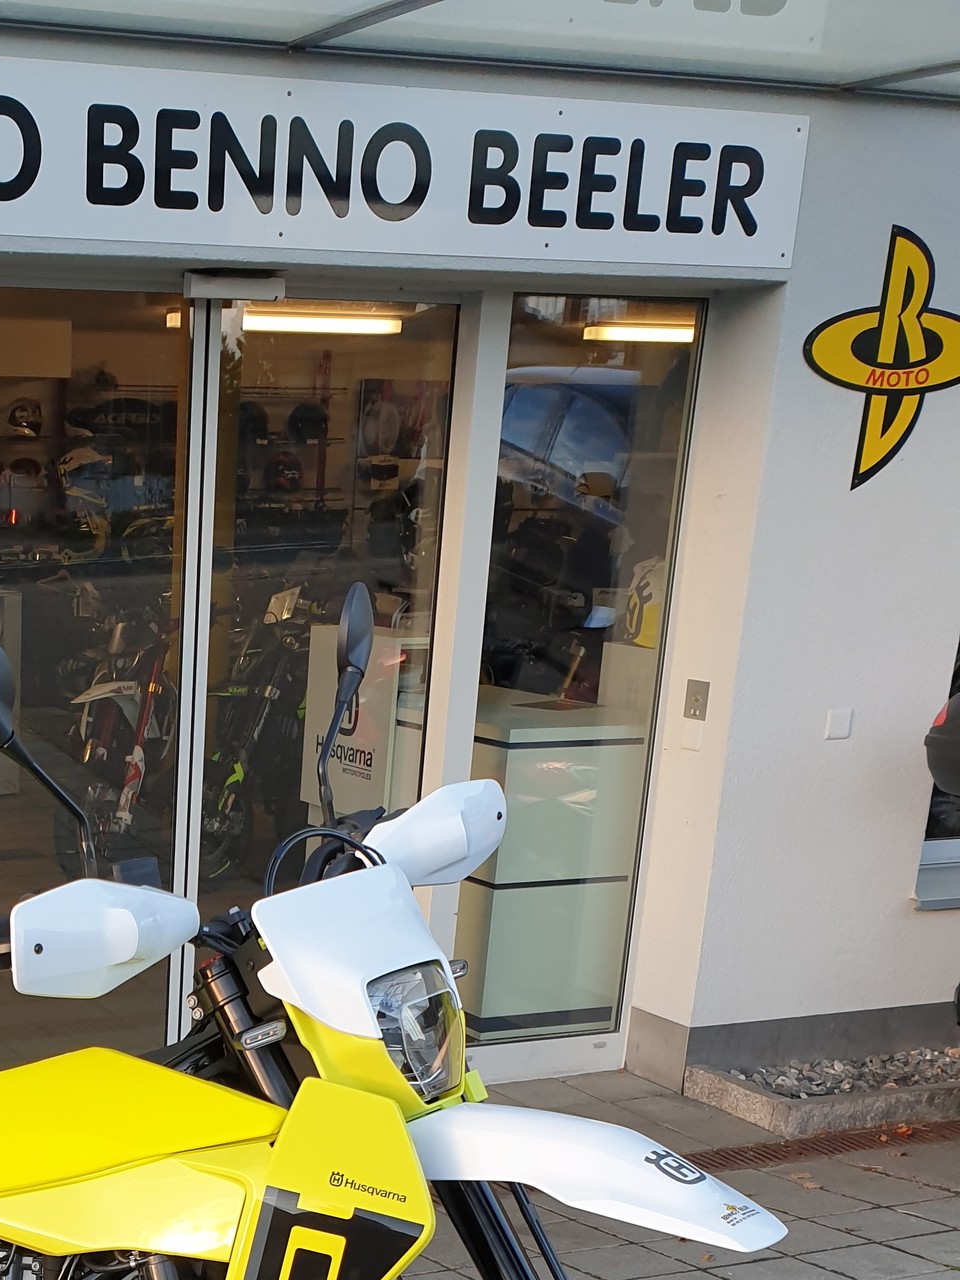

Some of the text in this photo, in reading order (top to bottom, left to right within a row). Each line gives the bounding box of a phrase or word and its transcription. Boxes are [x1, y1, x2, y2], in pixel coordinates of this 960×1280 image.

[86, 103, 432, 222] BENNO
[468, 129, 765, 237] BEELER
[865, 368, 930, 388] MOTO
[316, 734, 373, 768] Hsqvarna
[344, 1177, 407, 1204] Husqvarna
